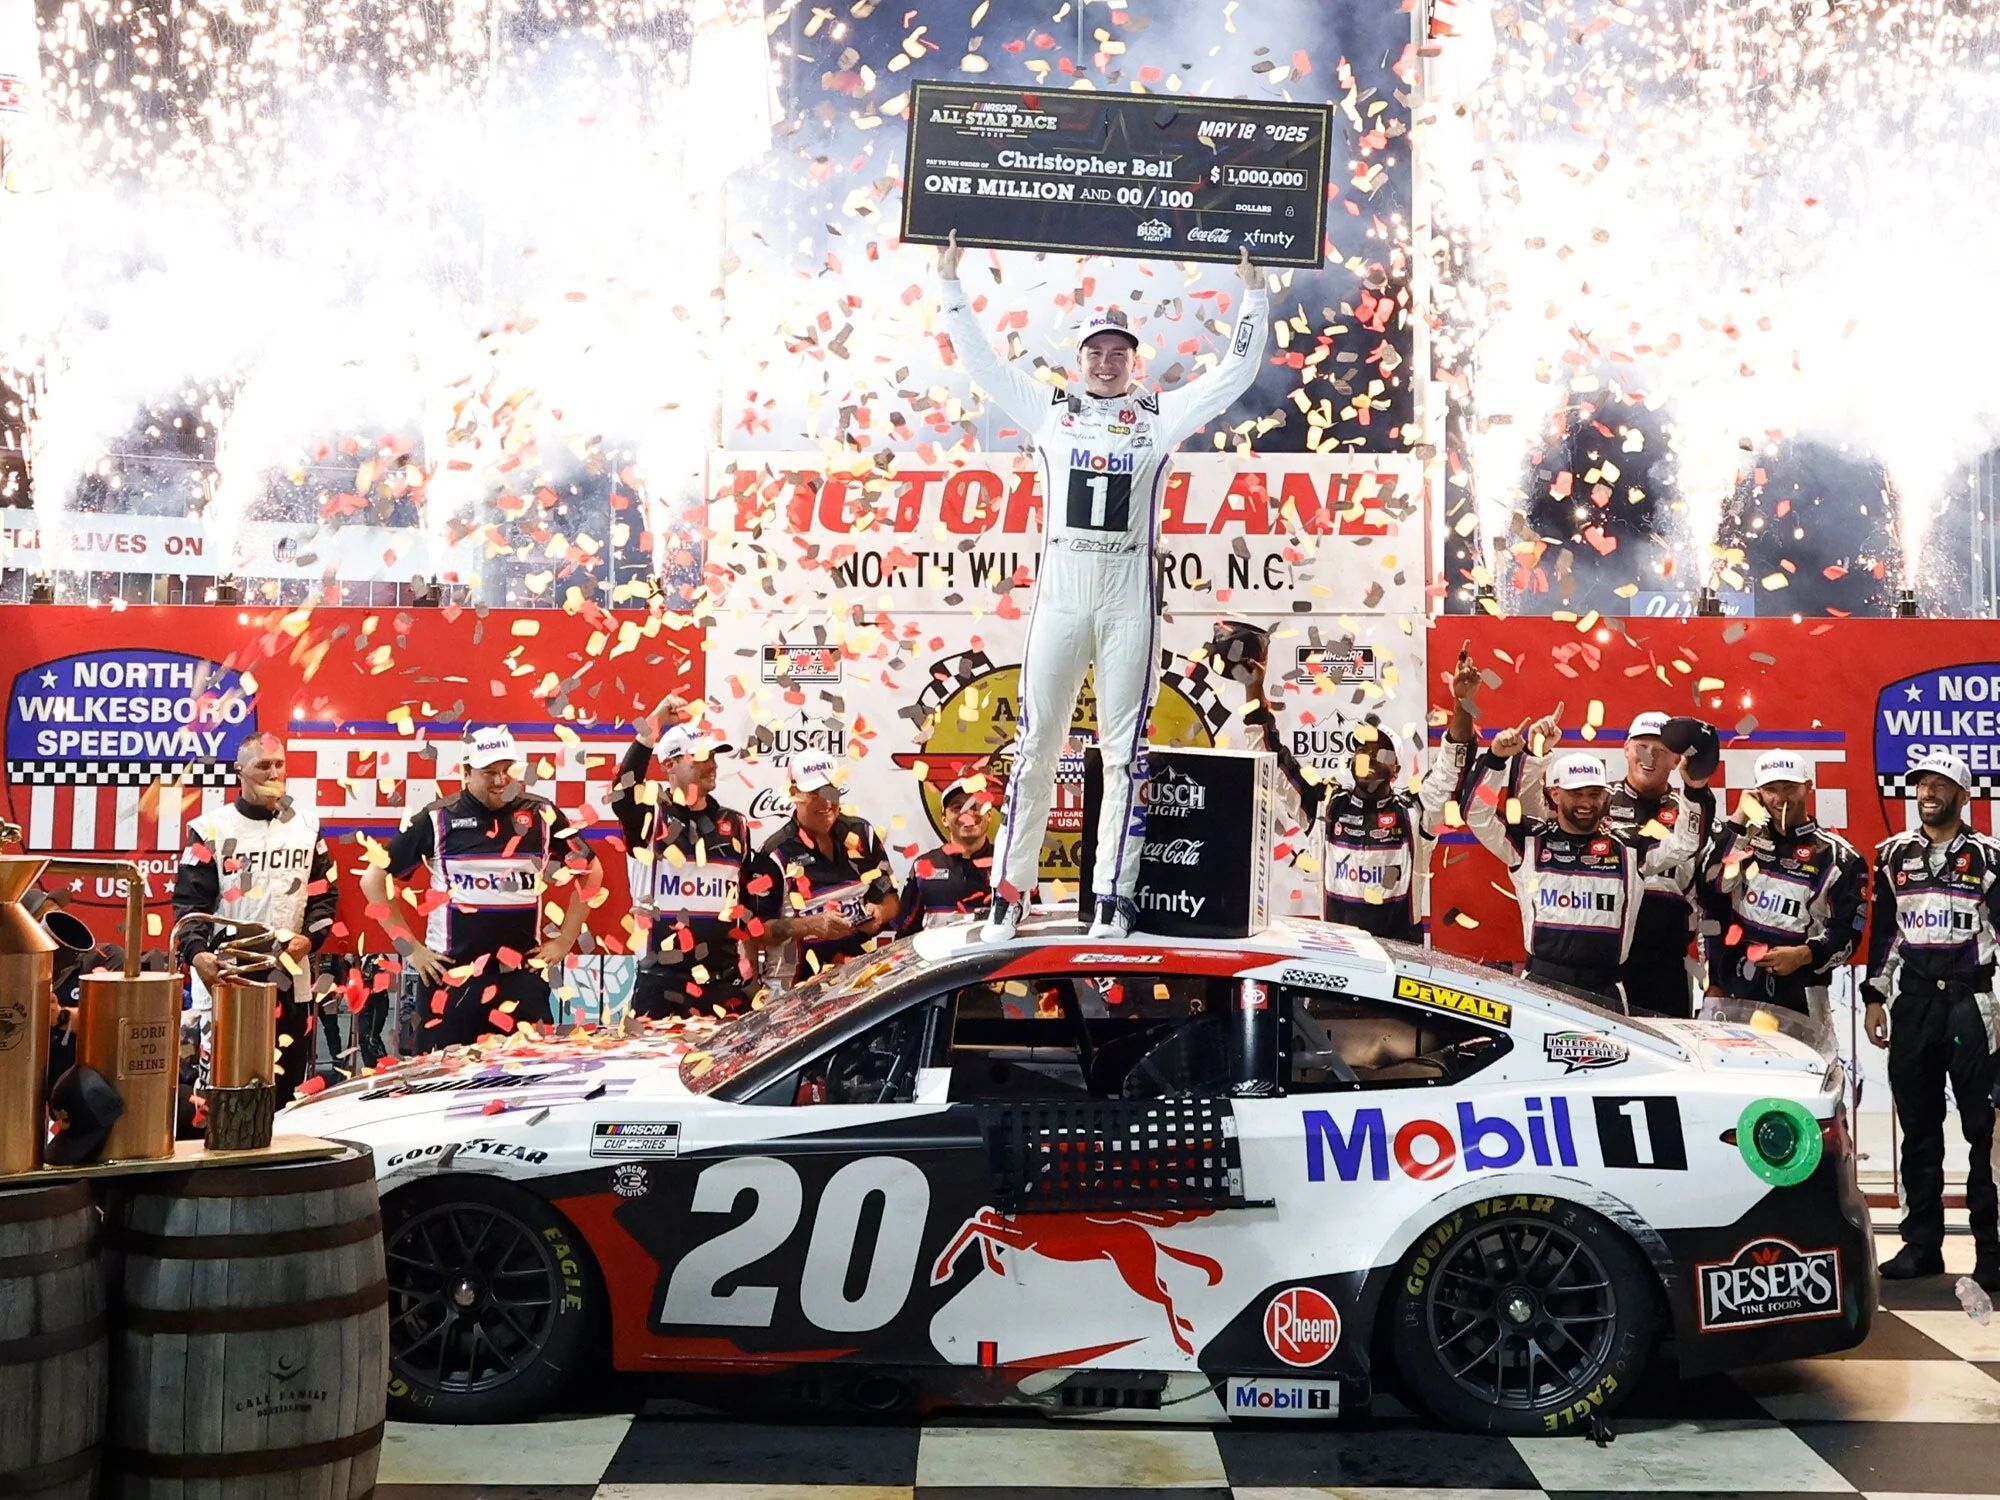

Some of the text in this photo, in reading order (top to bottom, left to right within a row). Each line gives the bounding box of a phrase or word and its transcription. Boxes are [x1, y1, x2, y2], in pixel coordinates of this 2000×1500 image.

[982, 102, 1018, 114] NASCAR
[929, 109, 1058, 130] ALL STAR RACE
[1198, 120, 1238, 139] MAY
[997, 150, 1127, 175] Christopher
[1131, 158, 1173, 178] Bell
[1210, 165, 1303, 187] $ 1,000,000
[924, 175, 972, 194] ONE
[977, 178, 1075, 201] MILLION
[1080, 189, 1111, 200] AND
[1235, 204, 1272, 213] DOLLARS
[1137, 224, 1172, 238] BUSCH
[1244, 229, 1295, 248] xfinity
[1070, 448, 1134, 472] Mobil
[1161, 472, 1398, 536] LANE
[165, 536, 203, 556] ON
[73, 662, 194, 688] NORTH
[17, 696, 247, 723] WILKESBORO
[36, 730, 227, 757] SPEEDWAY
[477, 741, 501, 751] Mobil
[803, 762, 827, 774] Mobil
[1568, 765, 1594, 774] Mobil
[1761, 761, 1784, 771] Mobil
[1259, 761, 1270, 843] SERIES
[1058, 818, 1081, 827] USA
[1257, 847, 1267, 893] CUP
[1335, 861, 1382, 884] Mobil
[660, 874, 722, 898] Mobil
[1540, 888, 1592, 910] Mobil
[1901, 910, 1949, 929] Mobil
[131, 1026, 166, 1039] BORN
[141, 1044, 157, 1054] TO
[1550, 1037, 1627, 1052] INTERSTATE
[1555, 1048, 1622, 1059] BATTERIES
[129, 1059, 166, 1070] SHINE
[621, 1125, 668, 1135] NASCAR
[1302, 1096, 1578, 1182] Mobil
[604, 1139, 627, 1149] CUP
[614, 1165, 648, 1179] NASCAR
[612, 1184, 648, 1197] SALUTES
[659, 1156, 931, 1333] 20
[542, 1227, 583, 1311] EAGLE
[1708, 1257, 1834, 1321] RESER'S
[1741, 1299, 1802, 1316] FINE FOODS
[1273, 1302, 1336, 1353] Rheem
[1236, 1386, 1303, 1409] Mobil
[1543, 1374, 1618, 1432] EAGLE
